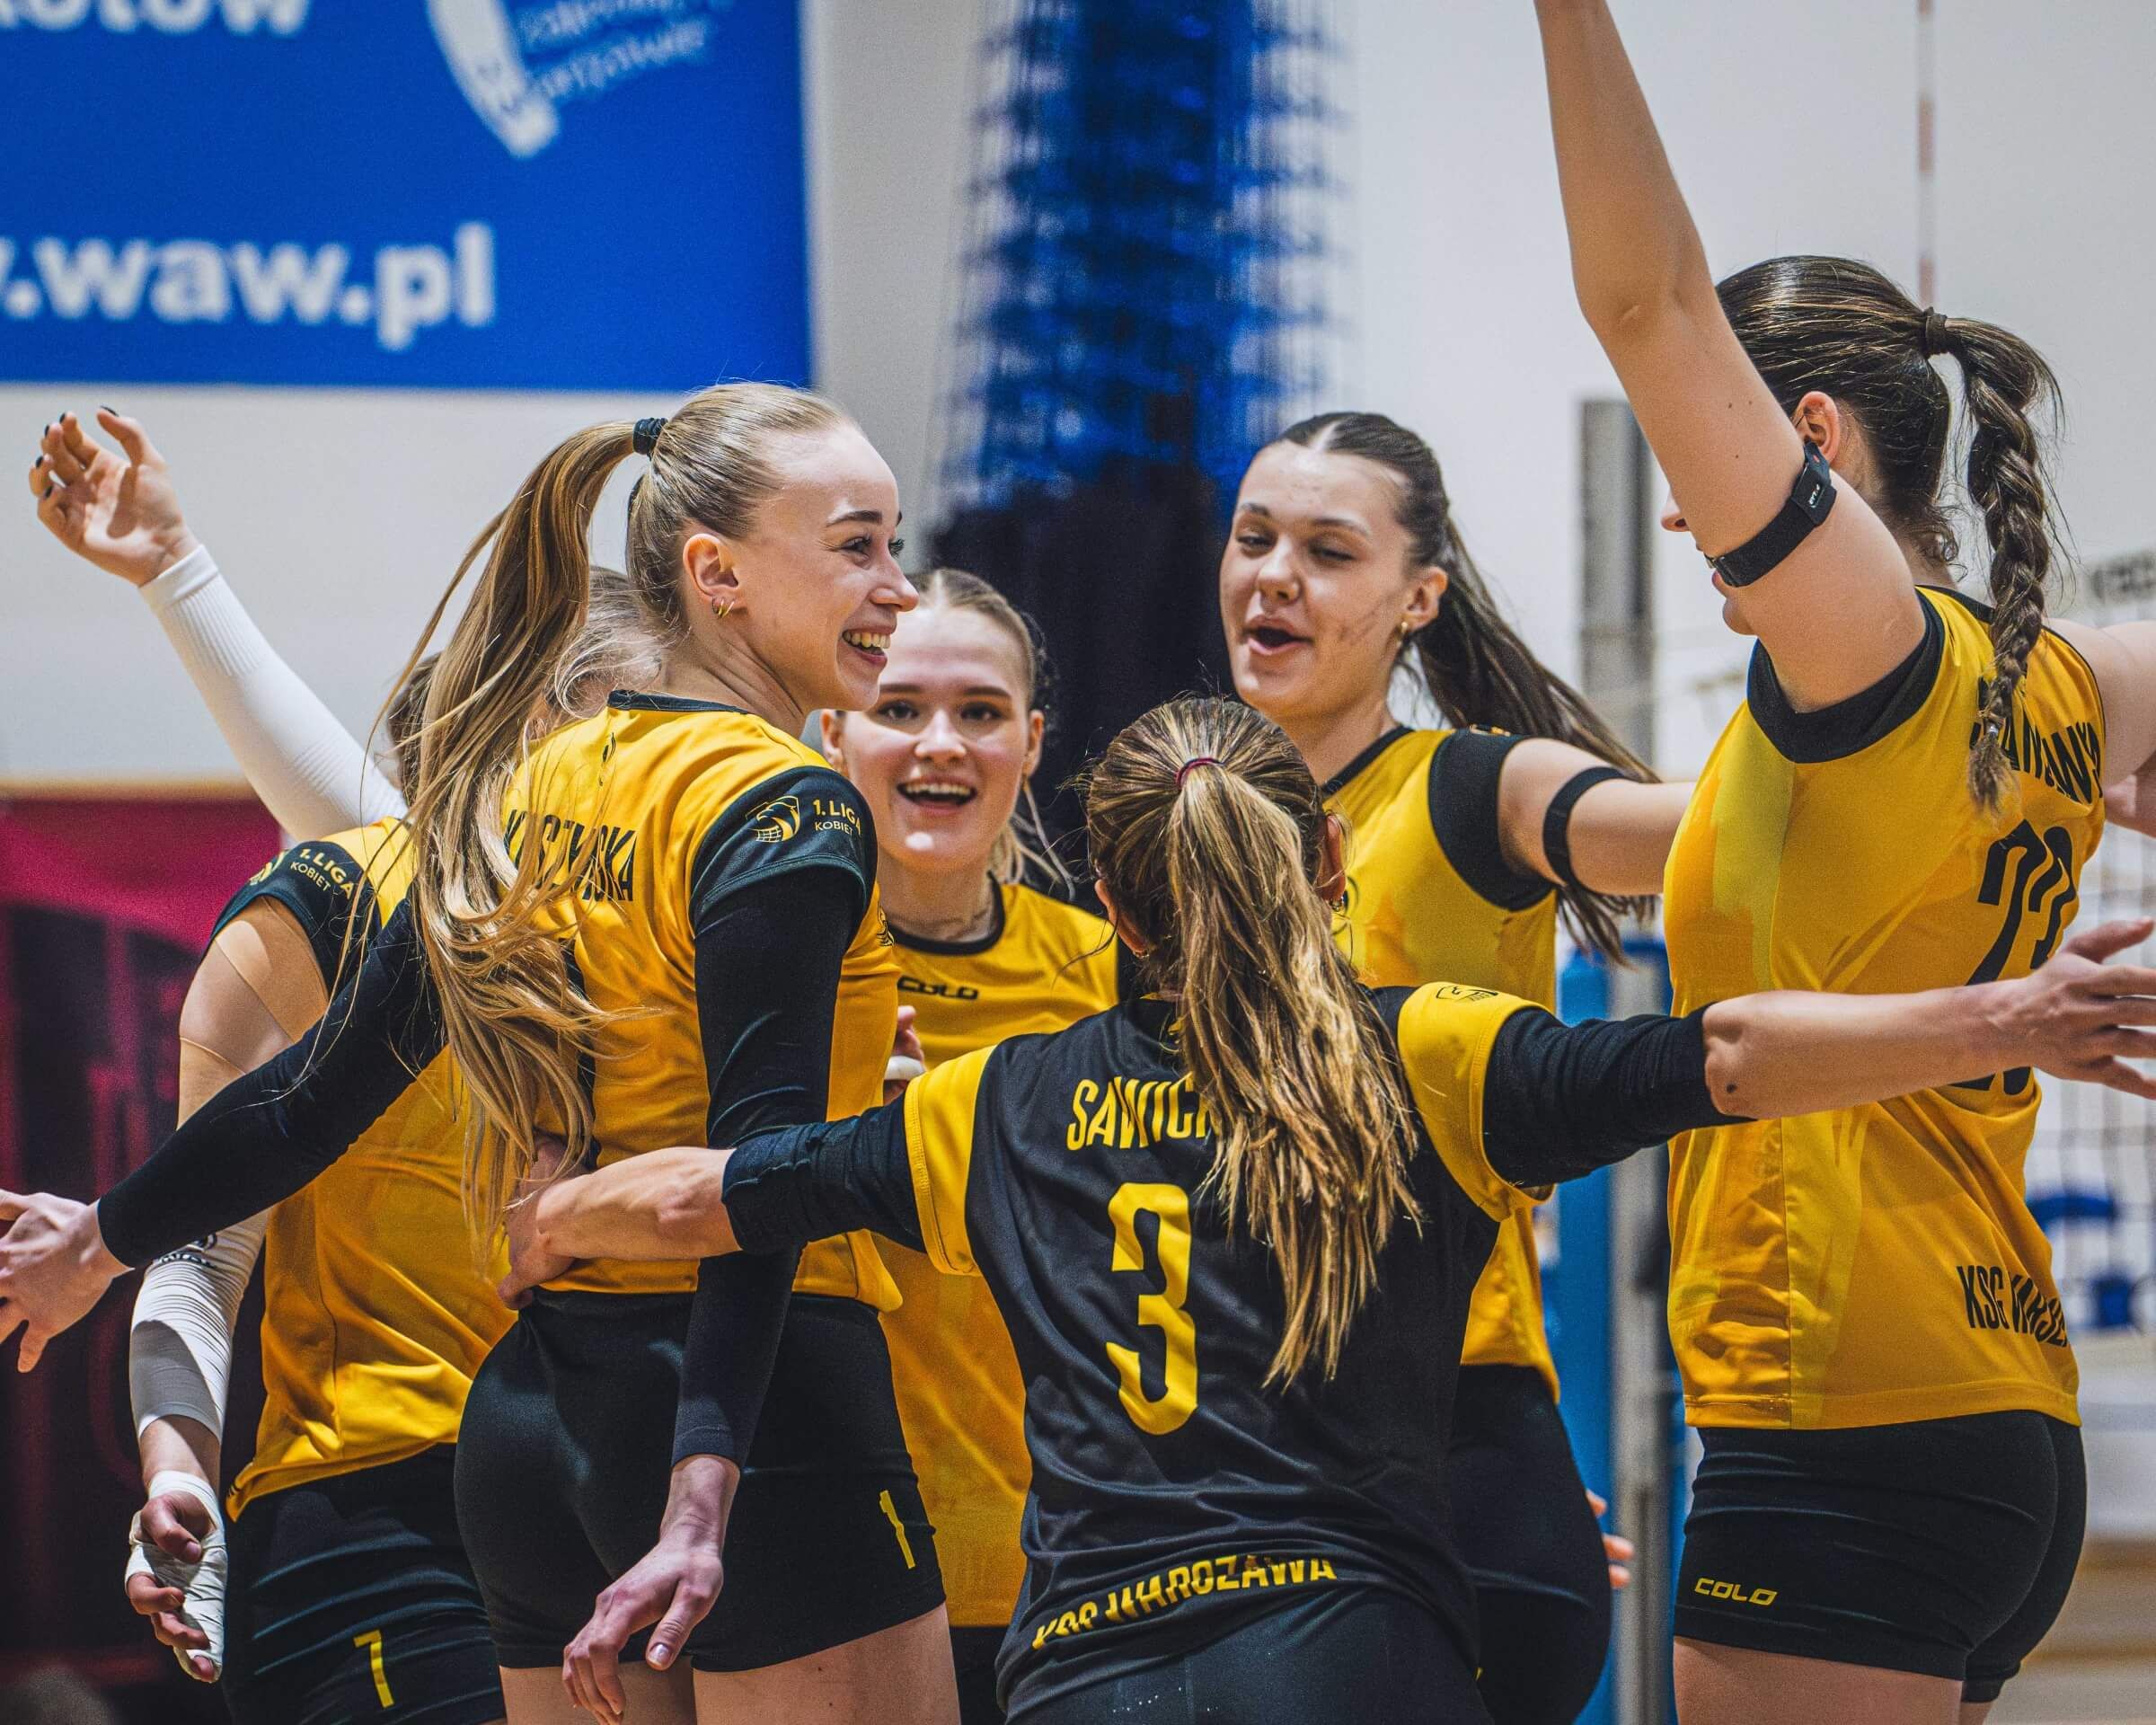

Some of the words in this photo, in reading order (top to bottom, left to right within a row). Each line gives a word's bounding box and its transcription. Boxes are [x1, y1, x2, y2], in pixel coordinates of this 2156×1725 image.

[0, 222, 495, 350] .waw.pl
[815, 821, 853, 836] KOBIET
[829, 800, 862, 836] LIGA
[290, 862, 331, 891] KOBIET
[313, 852, 354, 899] LIGA
[1106, 1181, 1198, 1435] 3
[1694, 1578, 1778, 1606] COLO
[353, 1630, 394, 1708] 7
